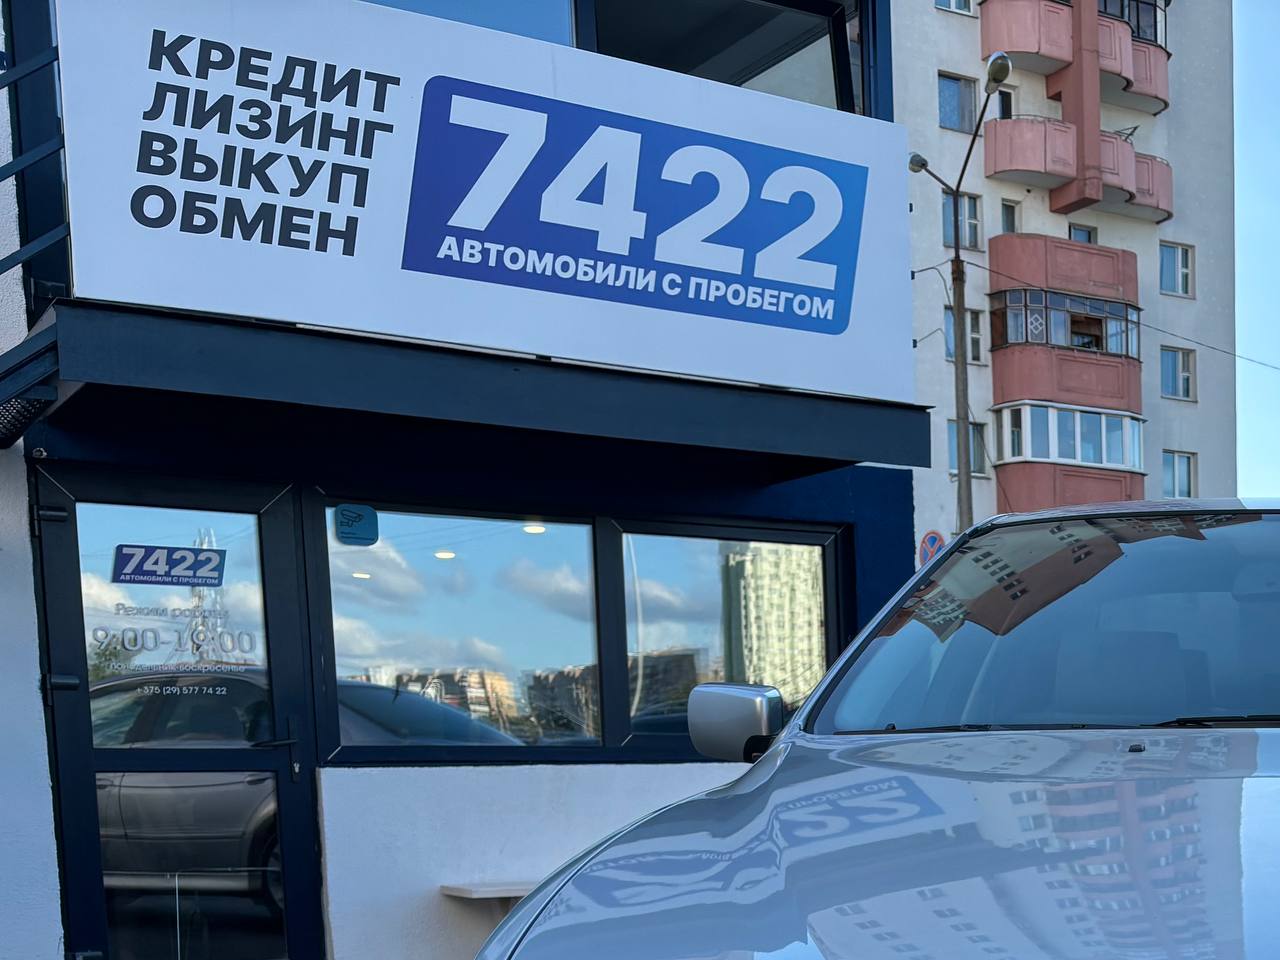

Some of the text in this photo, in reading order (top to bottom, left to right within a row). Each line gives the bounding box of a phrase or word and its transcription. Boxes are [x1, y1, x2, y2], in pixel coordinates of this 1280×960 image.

[148, 28, 401, 113] КРЕДИТ
[142, 81, 394, 160] ЛИЗИНГ
[135, 129, 370, 209] ВЫКУП
[447, 94, 843, 291] 7422
[130, 184, 359, 257] ОБМЕН
[436, 235, 835, 320] АВТОМОБИЛИ С ПРОБЕГОМ
[119, 574, 172, 583] АВТОМОБИЛИ
[179, 576, 219, 585] ПРОБЕГОМ
[121, 547, 220, 578] 7422
[137, 686, 227, 695] +375 (29) 577 74 22
